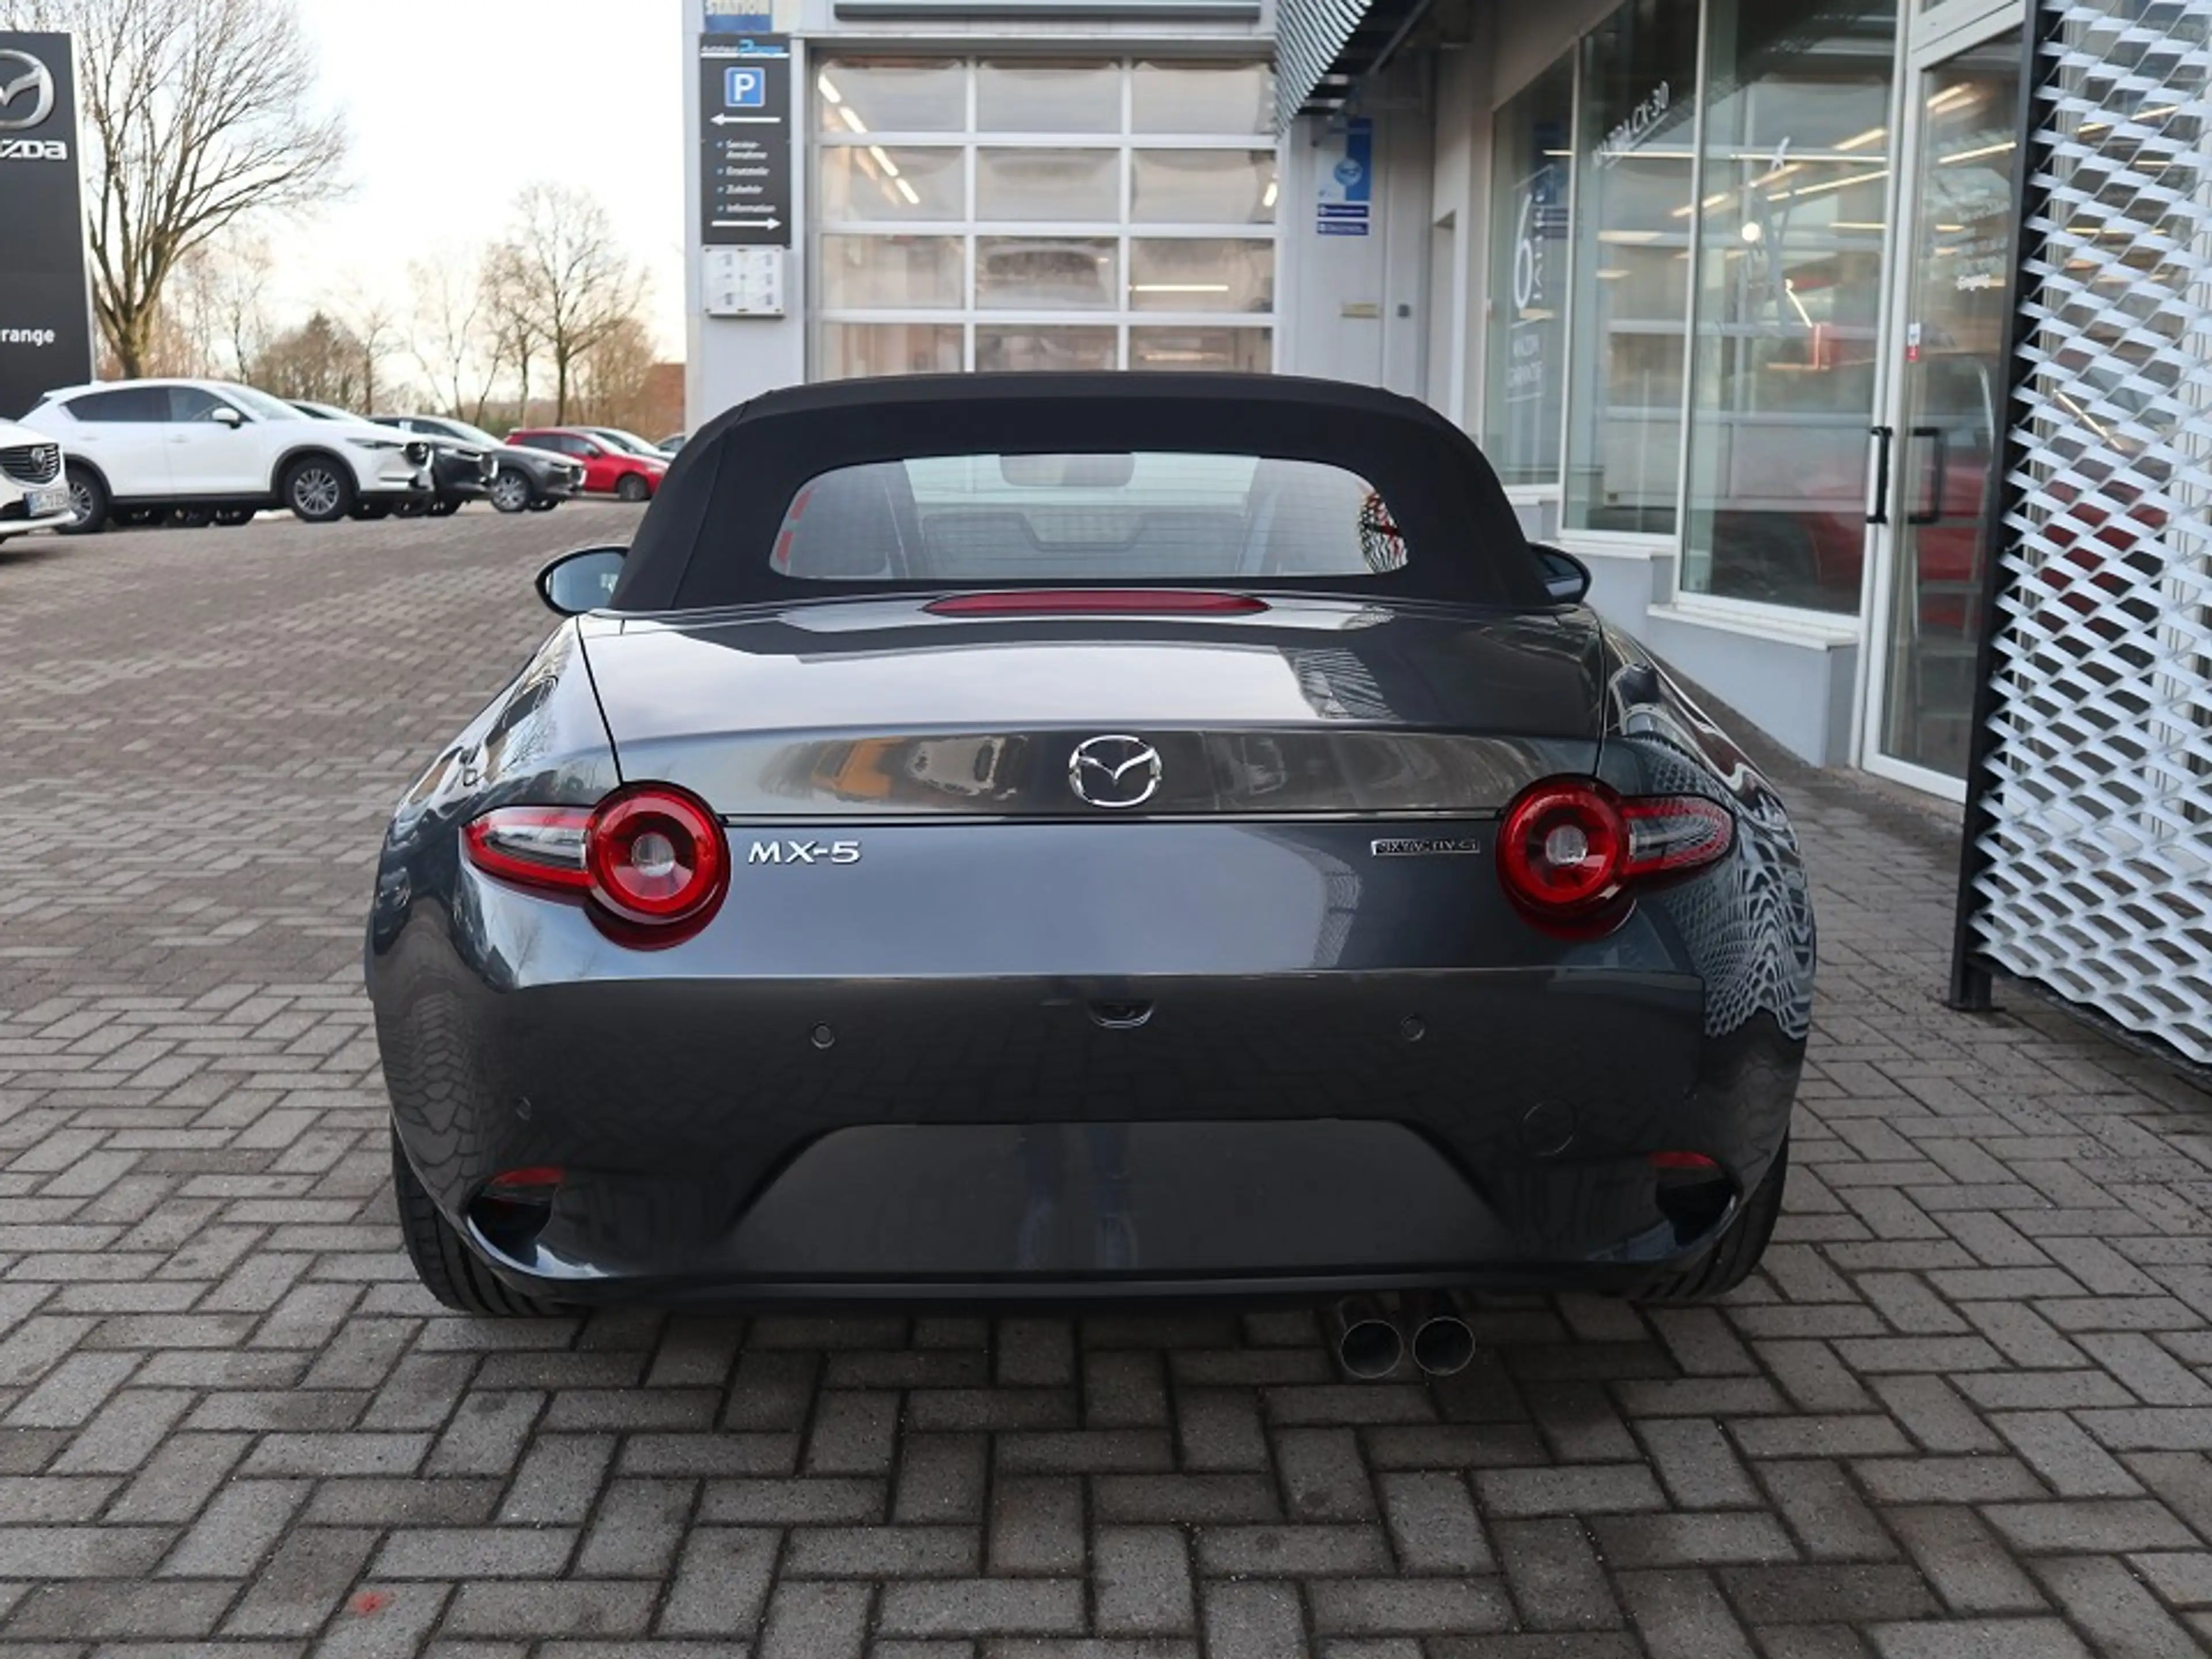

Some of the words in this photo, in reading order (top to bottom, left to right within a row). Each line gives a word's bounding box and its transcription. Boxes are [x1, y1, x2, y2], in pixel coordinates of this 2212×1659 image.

[734, 74, 755, 101] P
[0, 329, 56, 347] range
[748, 840, 861, 865] MX-5
